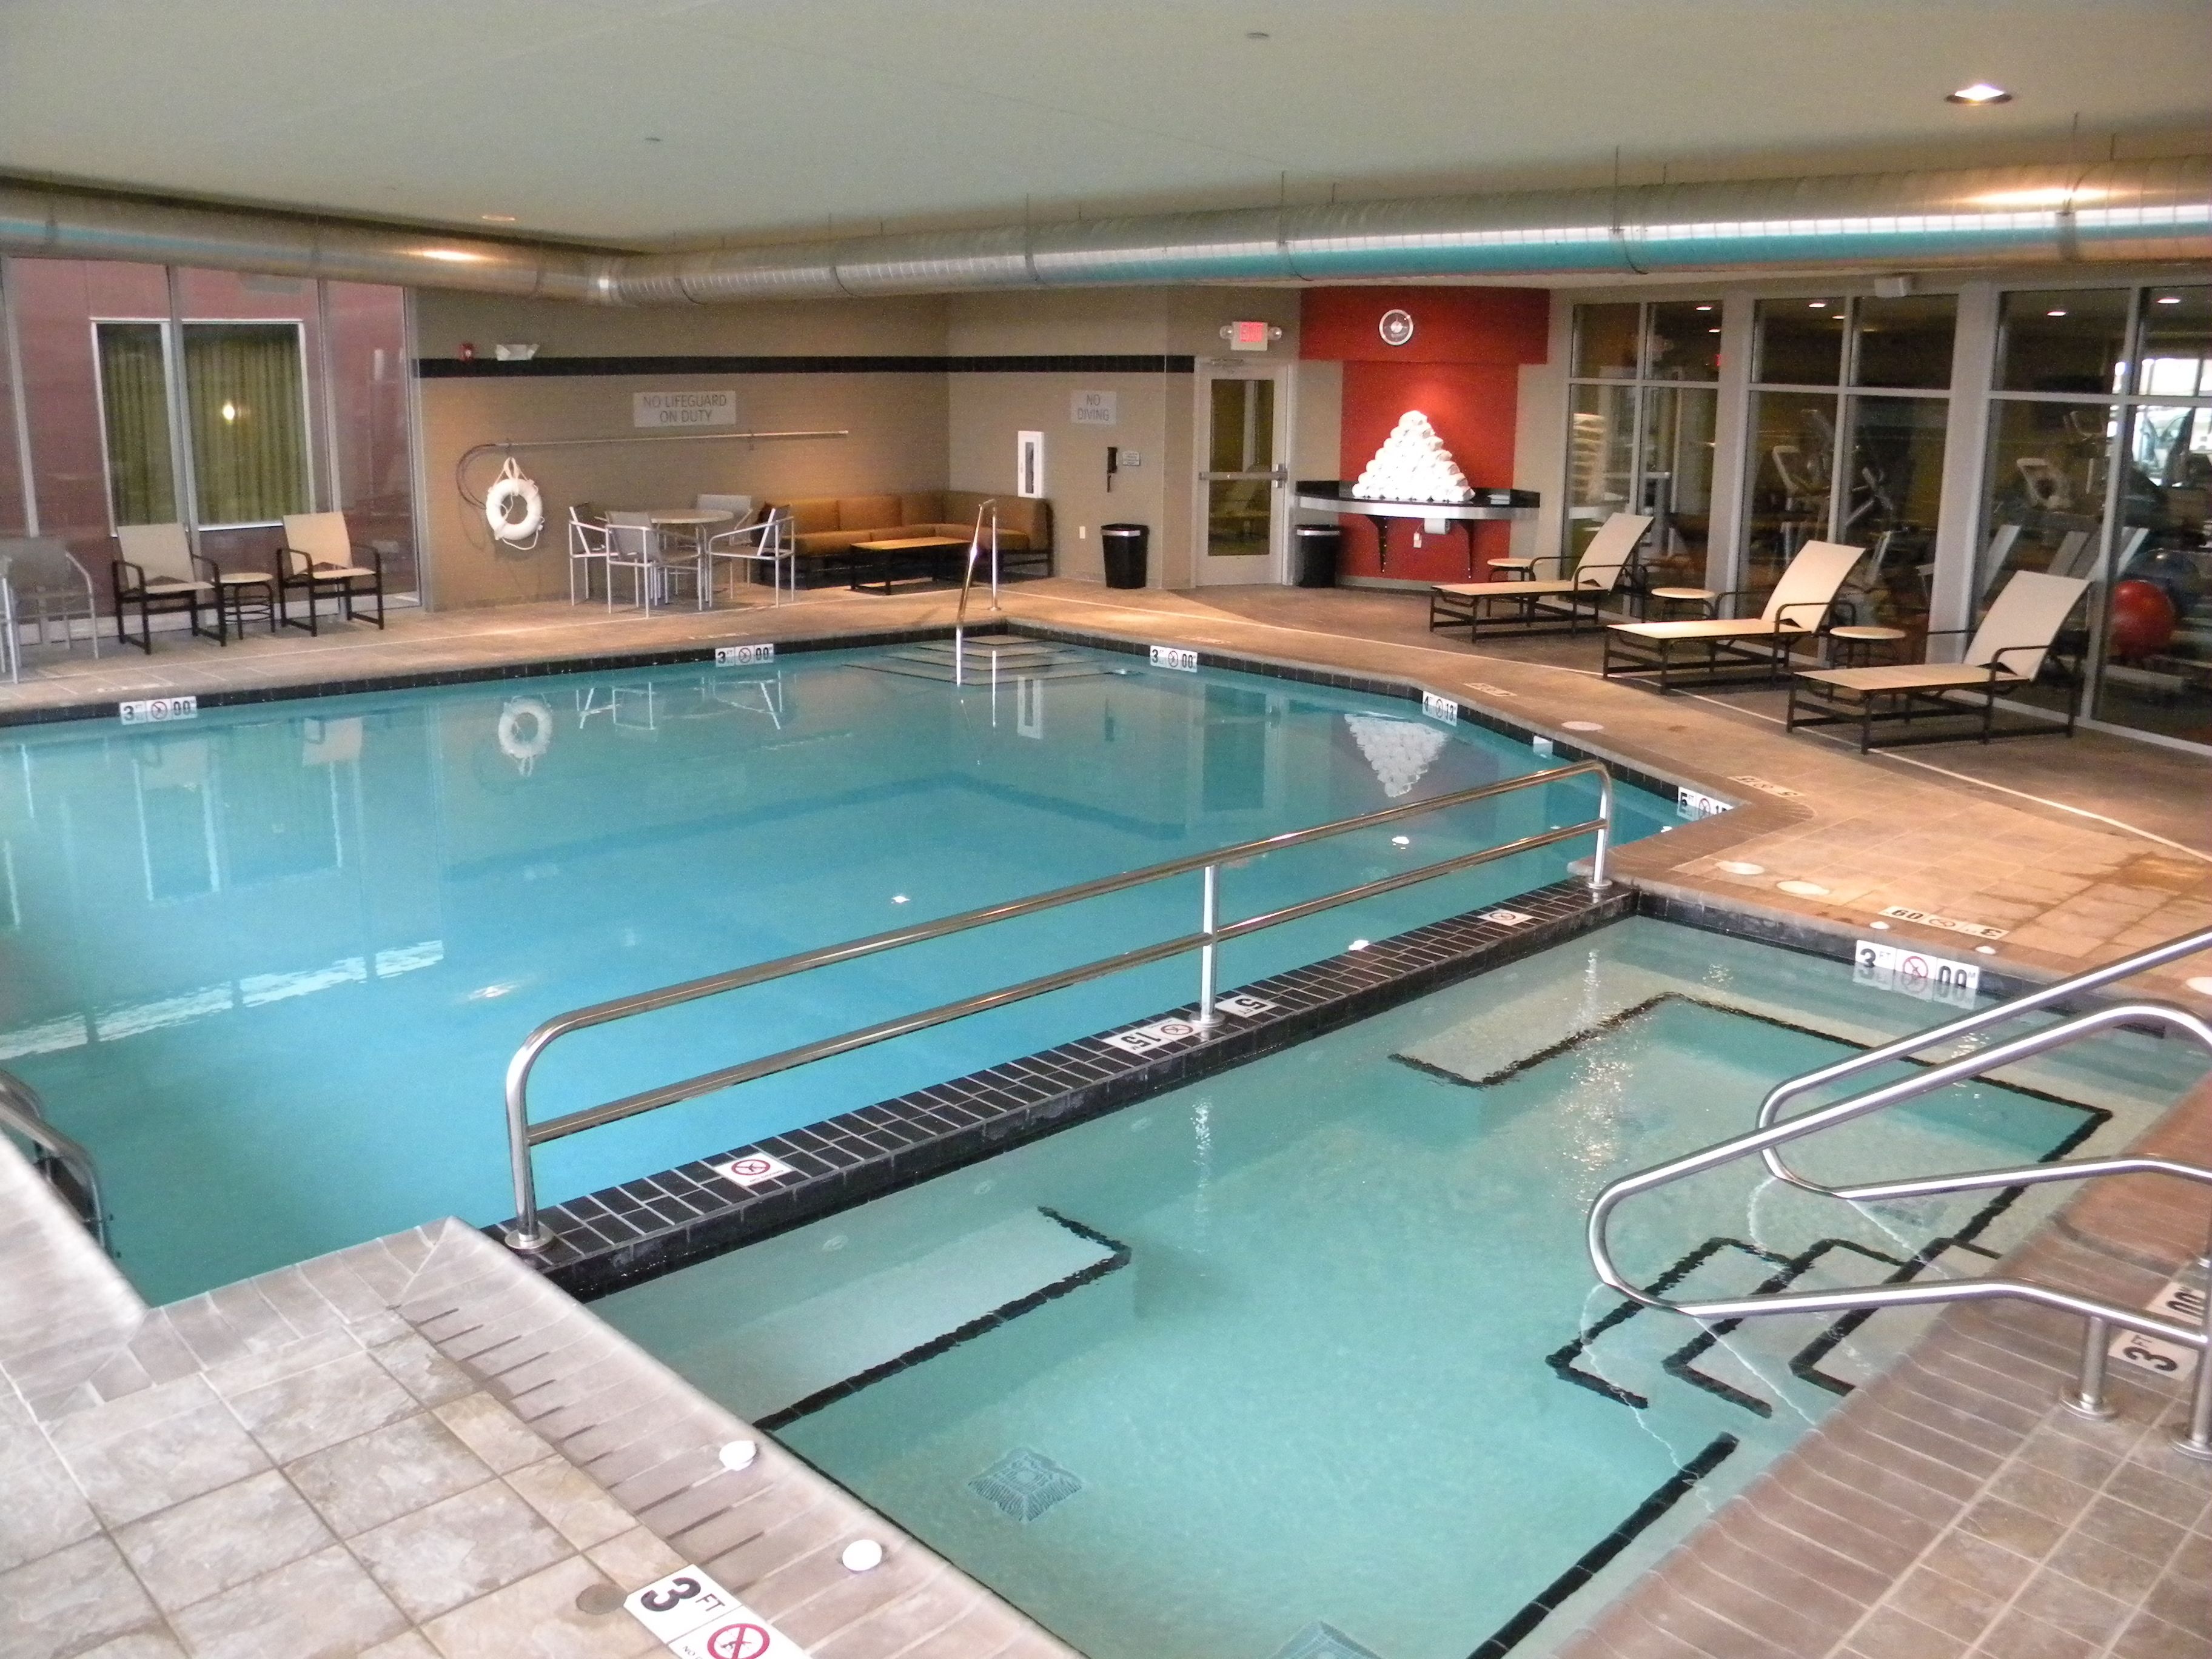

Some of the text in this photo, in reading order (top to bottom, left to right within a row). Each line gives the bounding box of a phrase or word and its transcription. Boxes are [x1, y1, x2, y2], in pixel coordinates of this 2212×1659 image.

[643, 394, 727, 408] NO LIFEGUARD
[1086, 394, 1100, 406] NO
[659, 409, 712, 423] ON DUTY
[1078, 407, 1109, 421] DIVING
[1860, 948, 1876, 968] 3
[2123, 1347, 2179, 1372] 3
[641, 1577, 726, 1612] 3 FT
